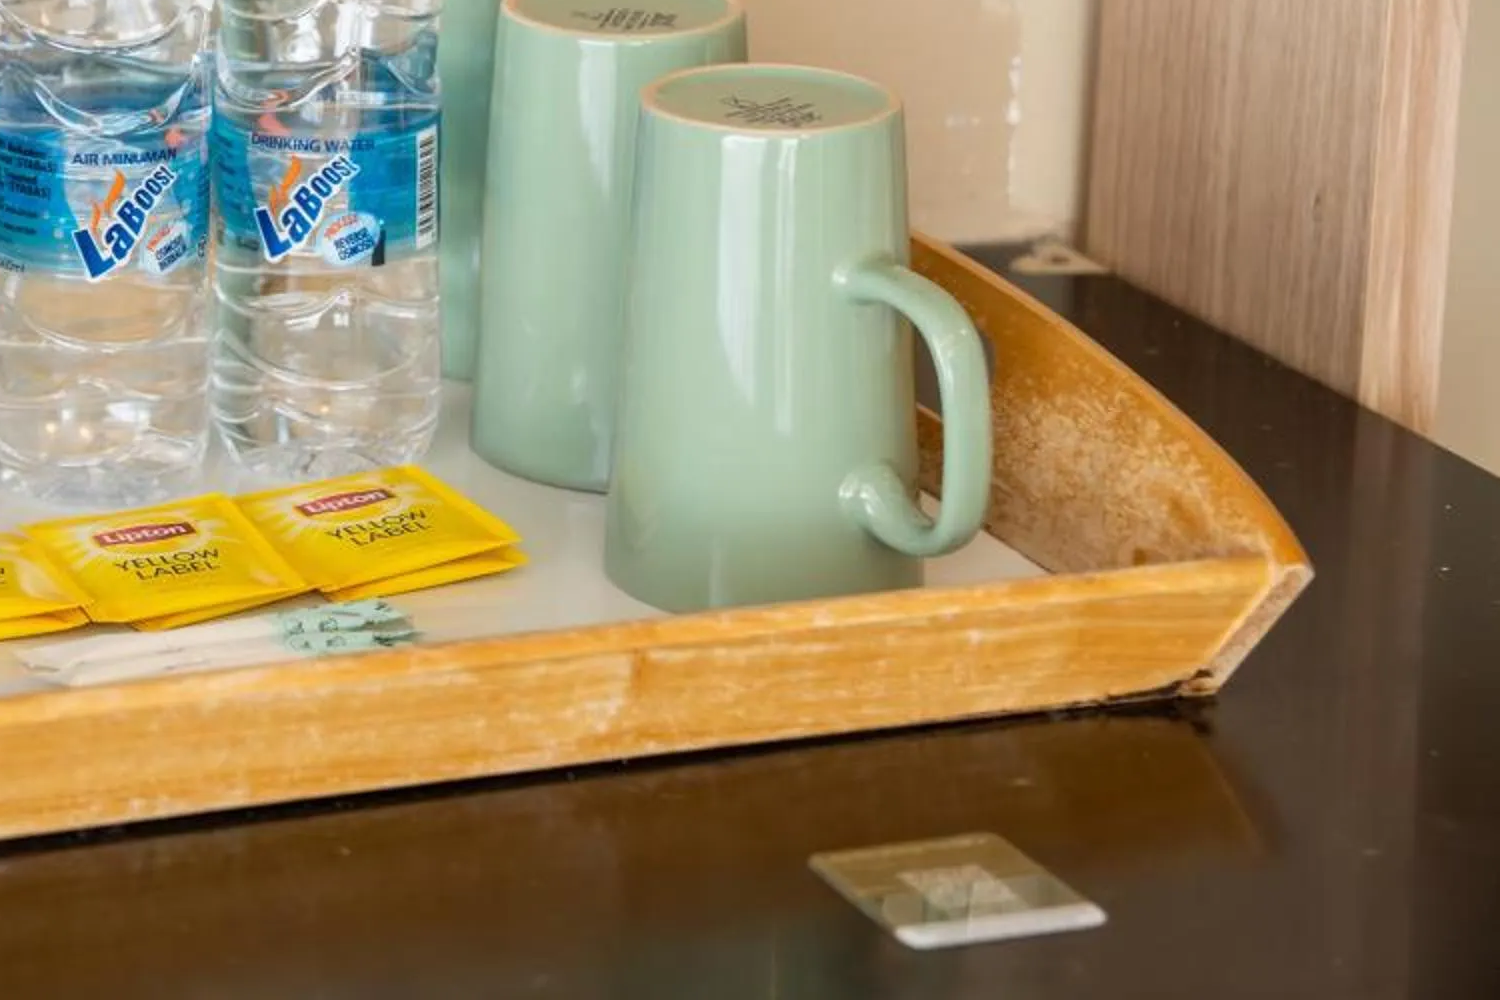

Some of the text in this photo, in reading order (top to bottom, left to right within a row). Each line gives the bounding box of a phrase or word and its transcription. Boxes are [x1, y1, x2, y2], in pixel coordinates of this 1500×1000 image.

[251, 132, 376, 153] DRINKING WATER
[72, 148, 177, 166] AIR MINUMAN
[303, 490, 386, 514] Lipton
[103, 525, 187, 544] Lipton
[325, 509, 426, 539] YELLOW
[349, 521, 431, 546] LABEL
[115, 547, 219, 572] YELLOW
[136, 561, 221, 580] LABEL
